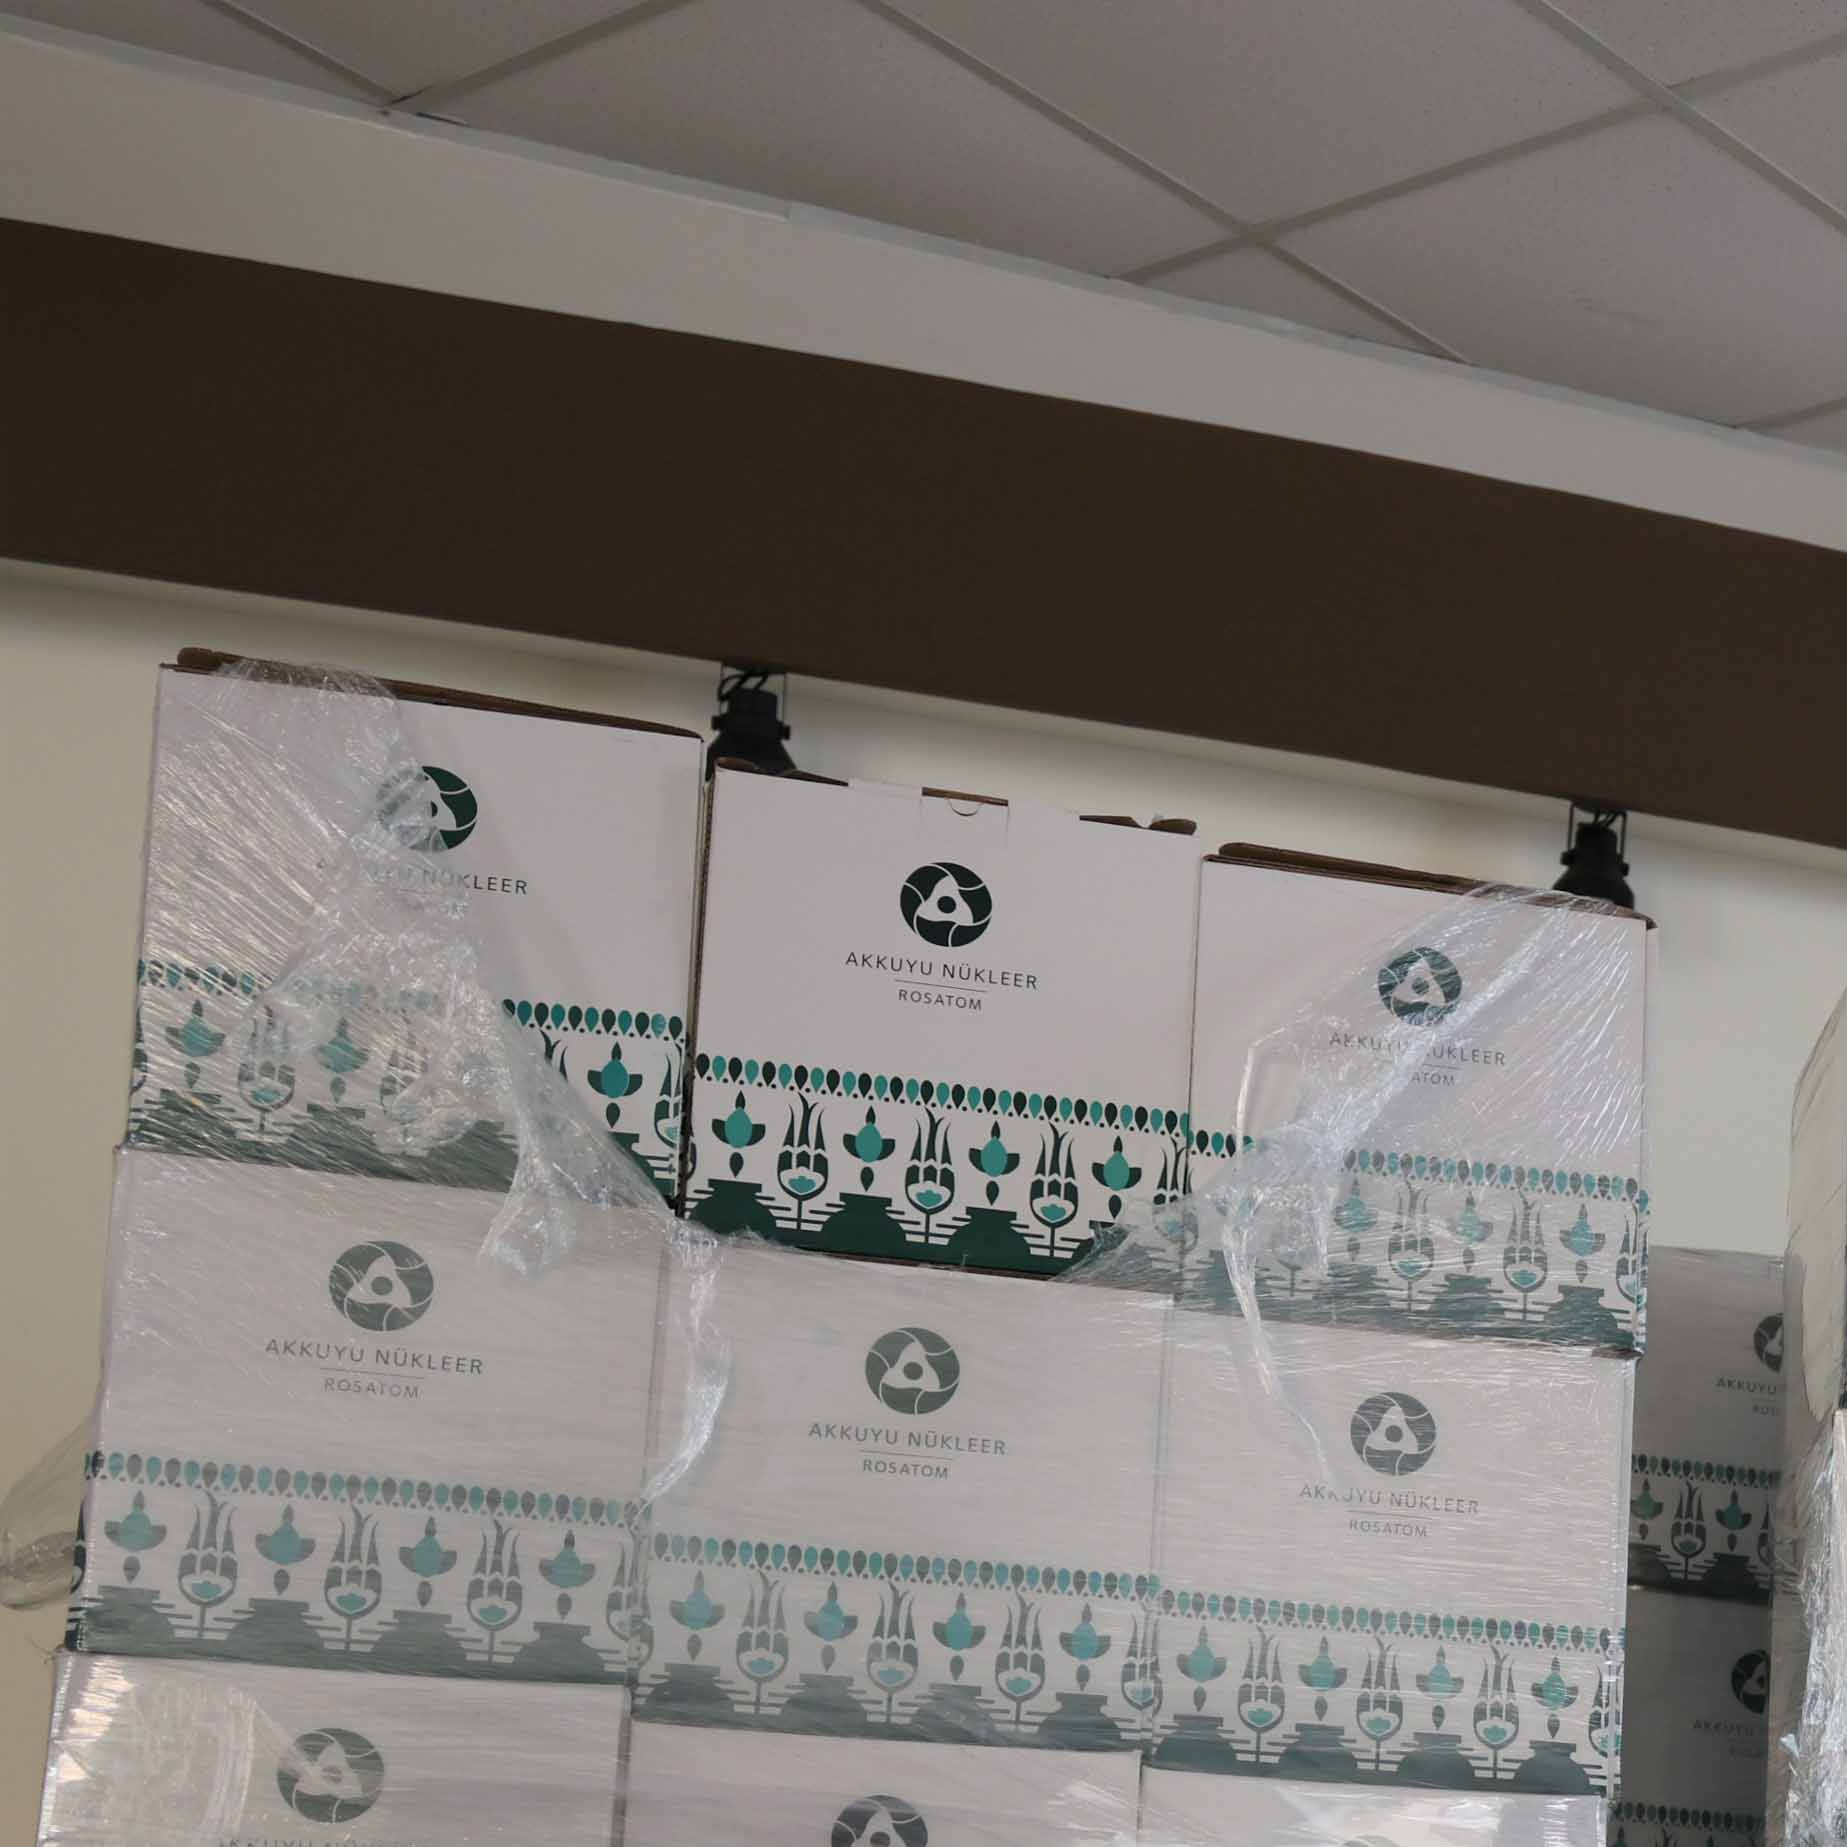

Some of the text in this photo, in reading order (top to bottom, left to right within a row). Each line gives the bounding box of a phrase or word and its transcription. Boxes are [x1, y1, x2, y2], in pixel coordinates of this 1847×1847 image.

[845, 952, 1038, 989] AKKUYU NÜKLEER
[898, 990, 983, 1010] ROSATOM
[265, 1339, 483, 1375] AKKUYU NÜKLEER
[323, 1379, 420, 1399] ROSATOM
[809, 1423, 1006, 1455] AKKUYU NÜKLEER
[863, 1459, 948, 1479] ROSATOM
[1389, 1489, 1479, 1514] NÜKLEER
[1348, 1519, 1427, 1536] ROSATOM
